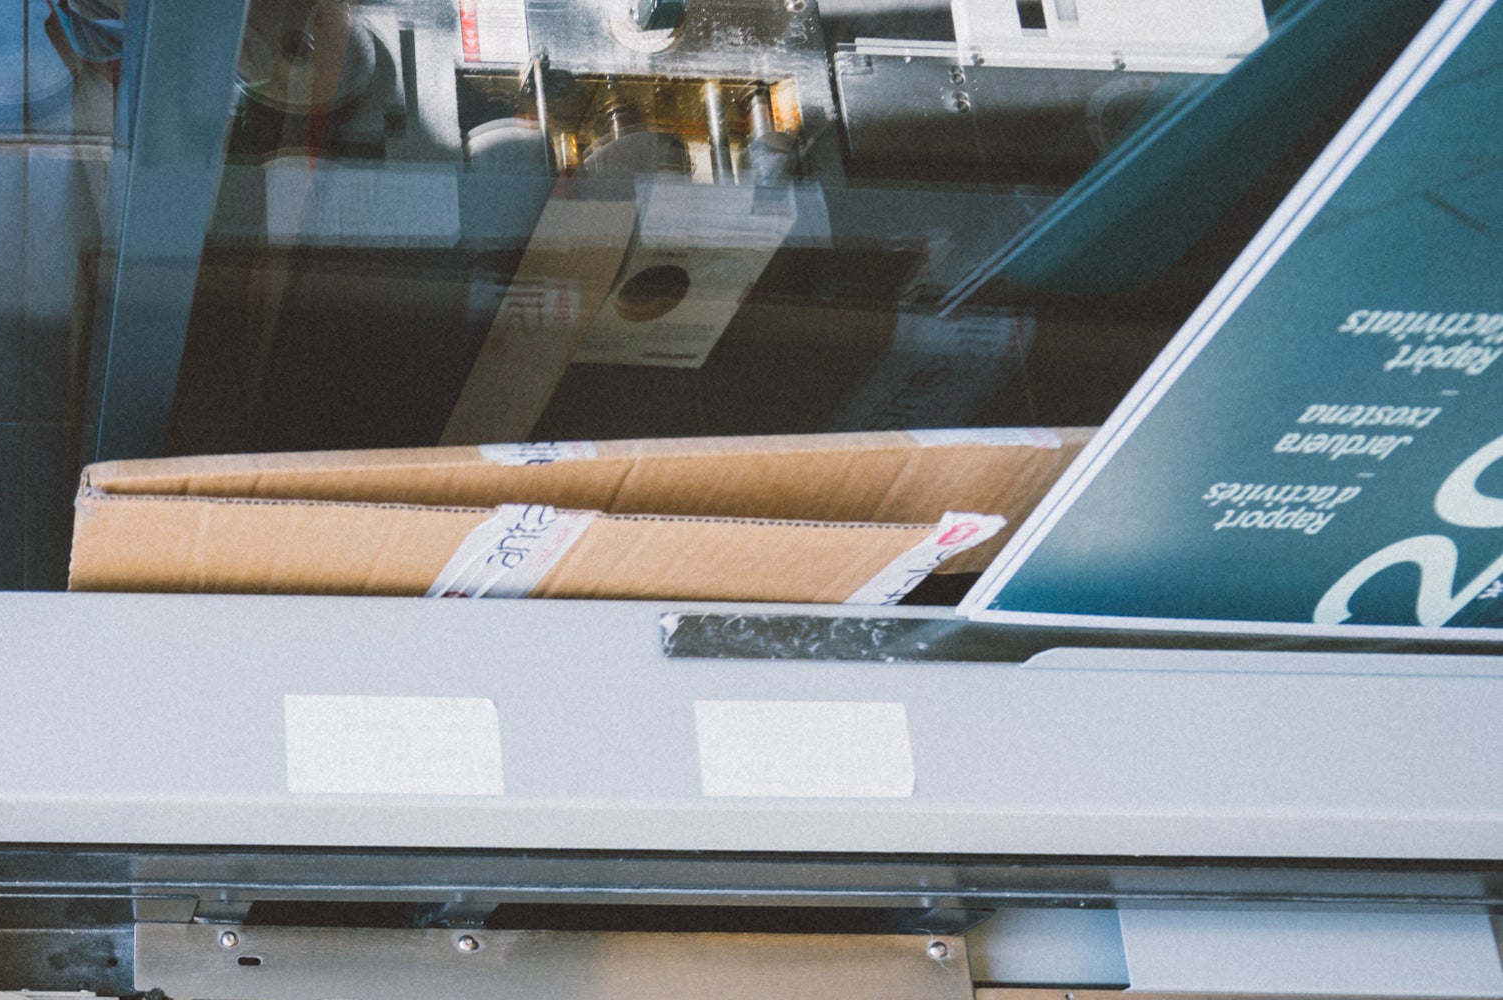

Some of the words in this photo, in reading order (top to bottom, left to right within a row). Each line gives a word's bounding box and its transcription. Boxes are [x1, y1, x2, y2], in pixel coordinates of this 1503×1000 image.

[1297, 403, 1443, 429] txostena
[1273, 432, 1414, 461] Jarduera
[1201, 482, 1363, 510] d'activités
[1213, 508, 1337, 536] Rapport
